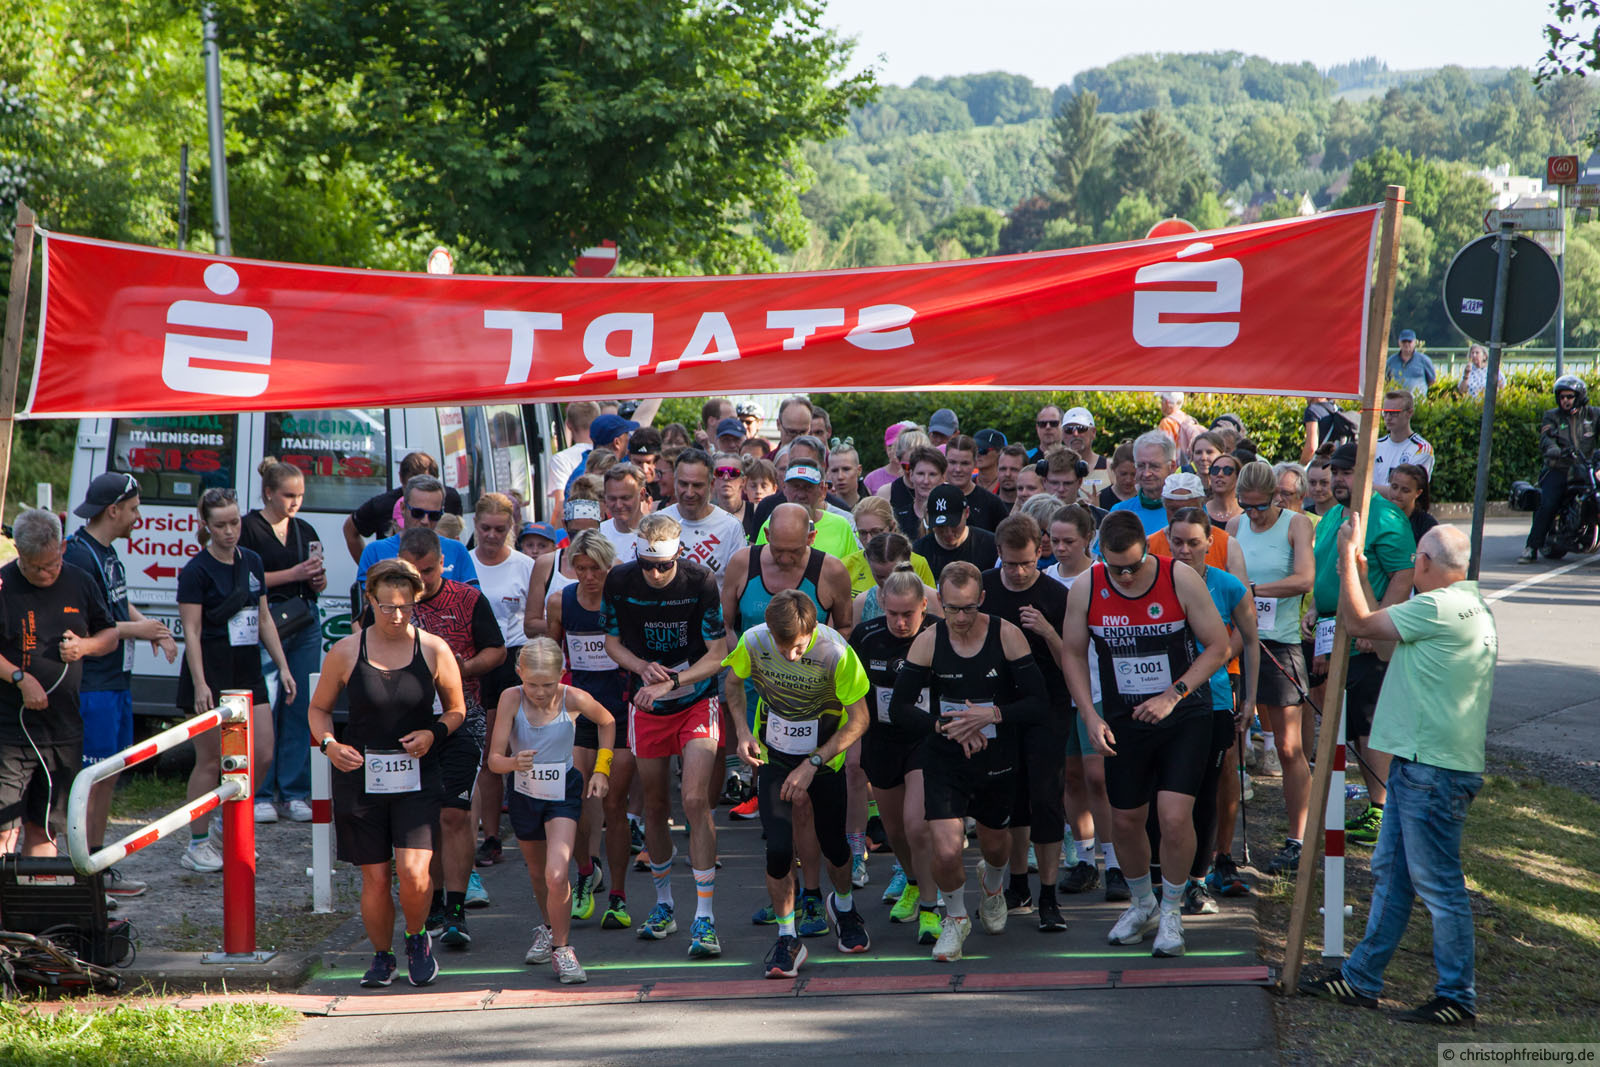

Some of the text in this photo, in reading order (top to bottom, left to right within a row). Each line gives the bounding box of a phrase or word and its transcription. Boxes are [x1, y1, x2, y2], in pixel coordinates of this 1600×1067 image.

[1556, 162, 1570, 173] 40
[281, 417, 375, 436] ORIGINAL
[129, 430, 224, 446] ITALIENISCHES
[281, 437, 376, 452] ITALIENISCHES
[129, 447, 222, 473] EIS
[131, 512, 200, 533] orsich
[127, 537, 204, 557] Kinde
[1102, 615, 1130, 626] RWO
[645, 628, 679, 642] RUN
[1103, 623, 1174, 638] ENDURANCE
[584, 640, 606, 652] 109
[647, 641, 679, 652] CREW
[1105, 637, 1137, 648] TEAM
[1134, 660, 1164, 675] 1001
[775, 679, 811, 690] MENDEN
[784, 726, 812, 737] 1283
[385, 759, 414, 773] 1151
[531, 769, 560, 781] 1150
